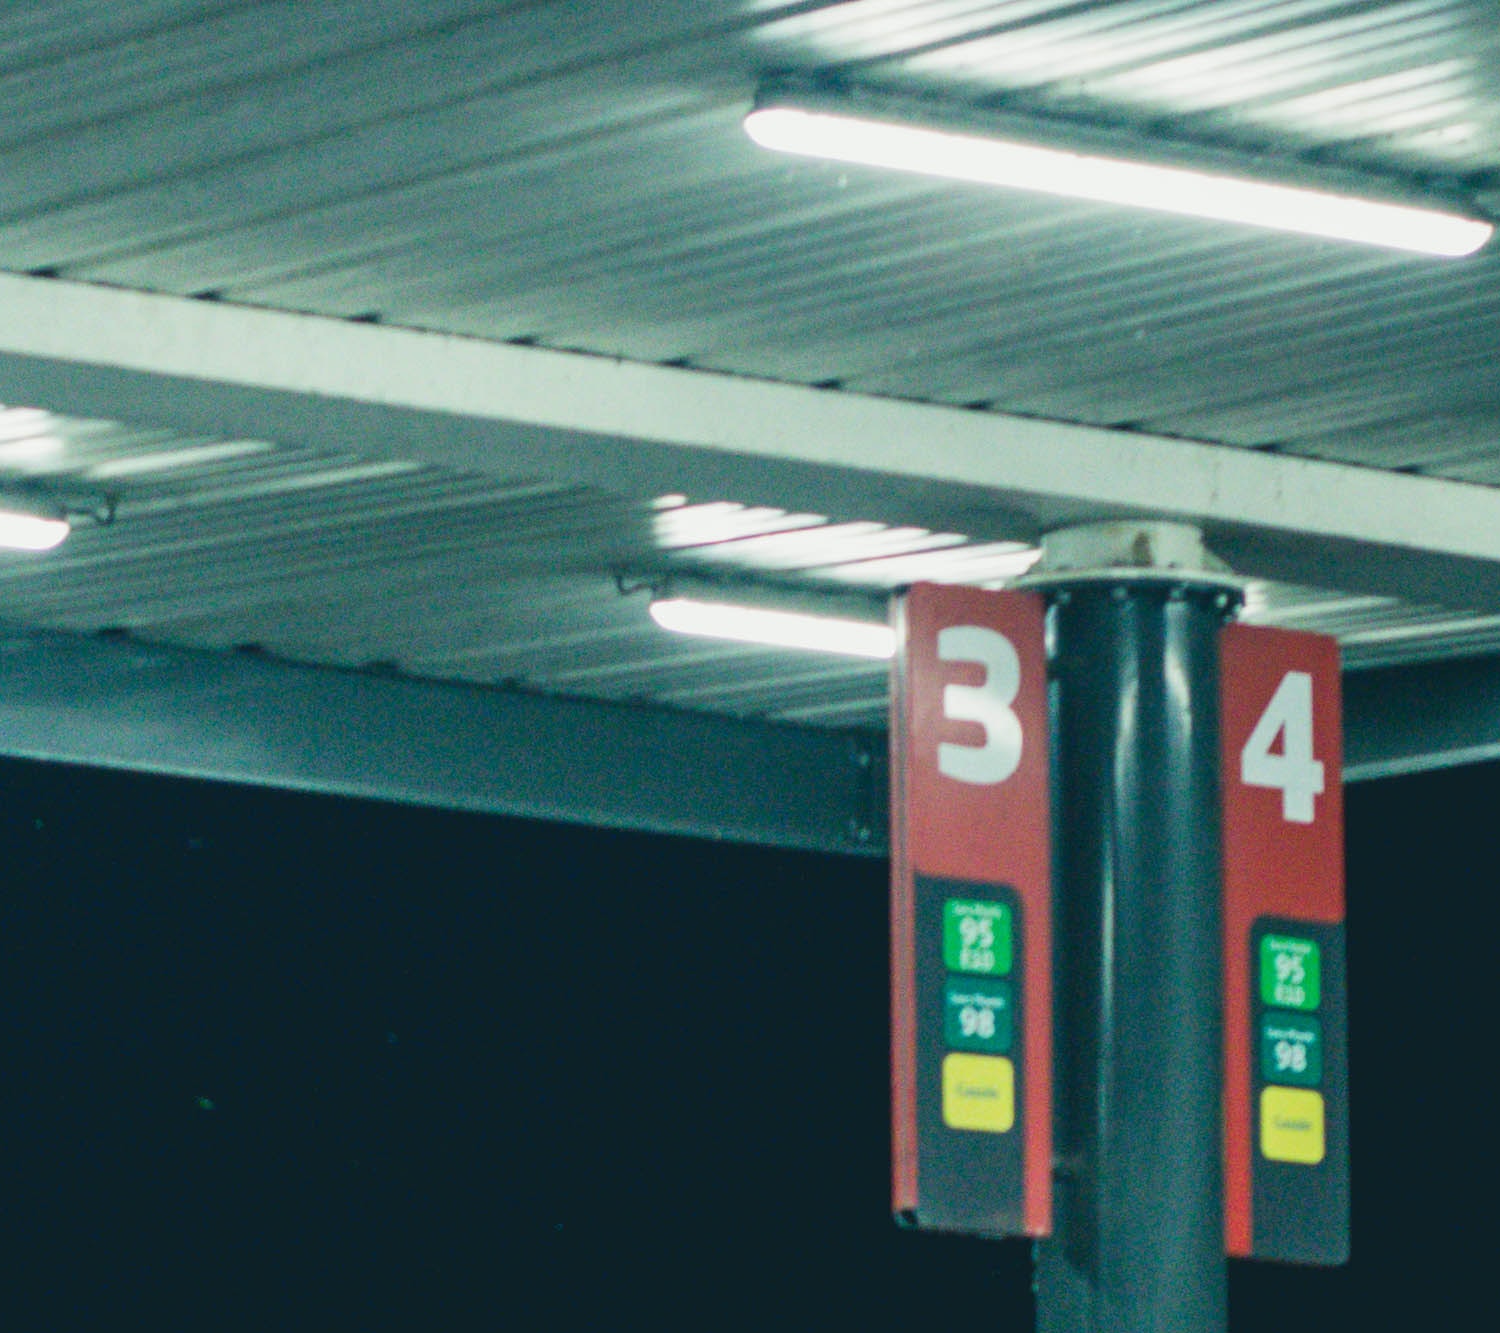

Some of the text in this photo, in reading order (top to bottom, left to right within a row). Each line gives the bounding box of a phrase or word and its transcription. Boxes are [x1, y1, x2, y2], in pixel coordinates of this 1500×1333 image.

[936, 624, 1023, 785] 3
[1240, 670, 1324, 824] 4
[959, 916, 996, 949] 95
[958, 1006, 996, 1039] 98
[1274, 1039, 1308, 1073] 98
